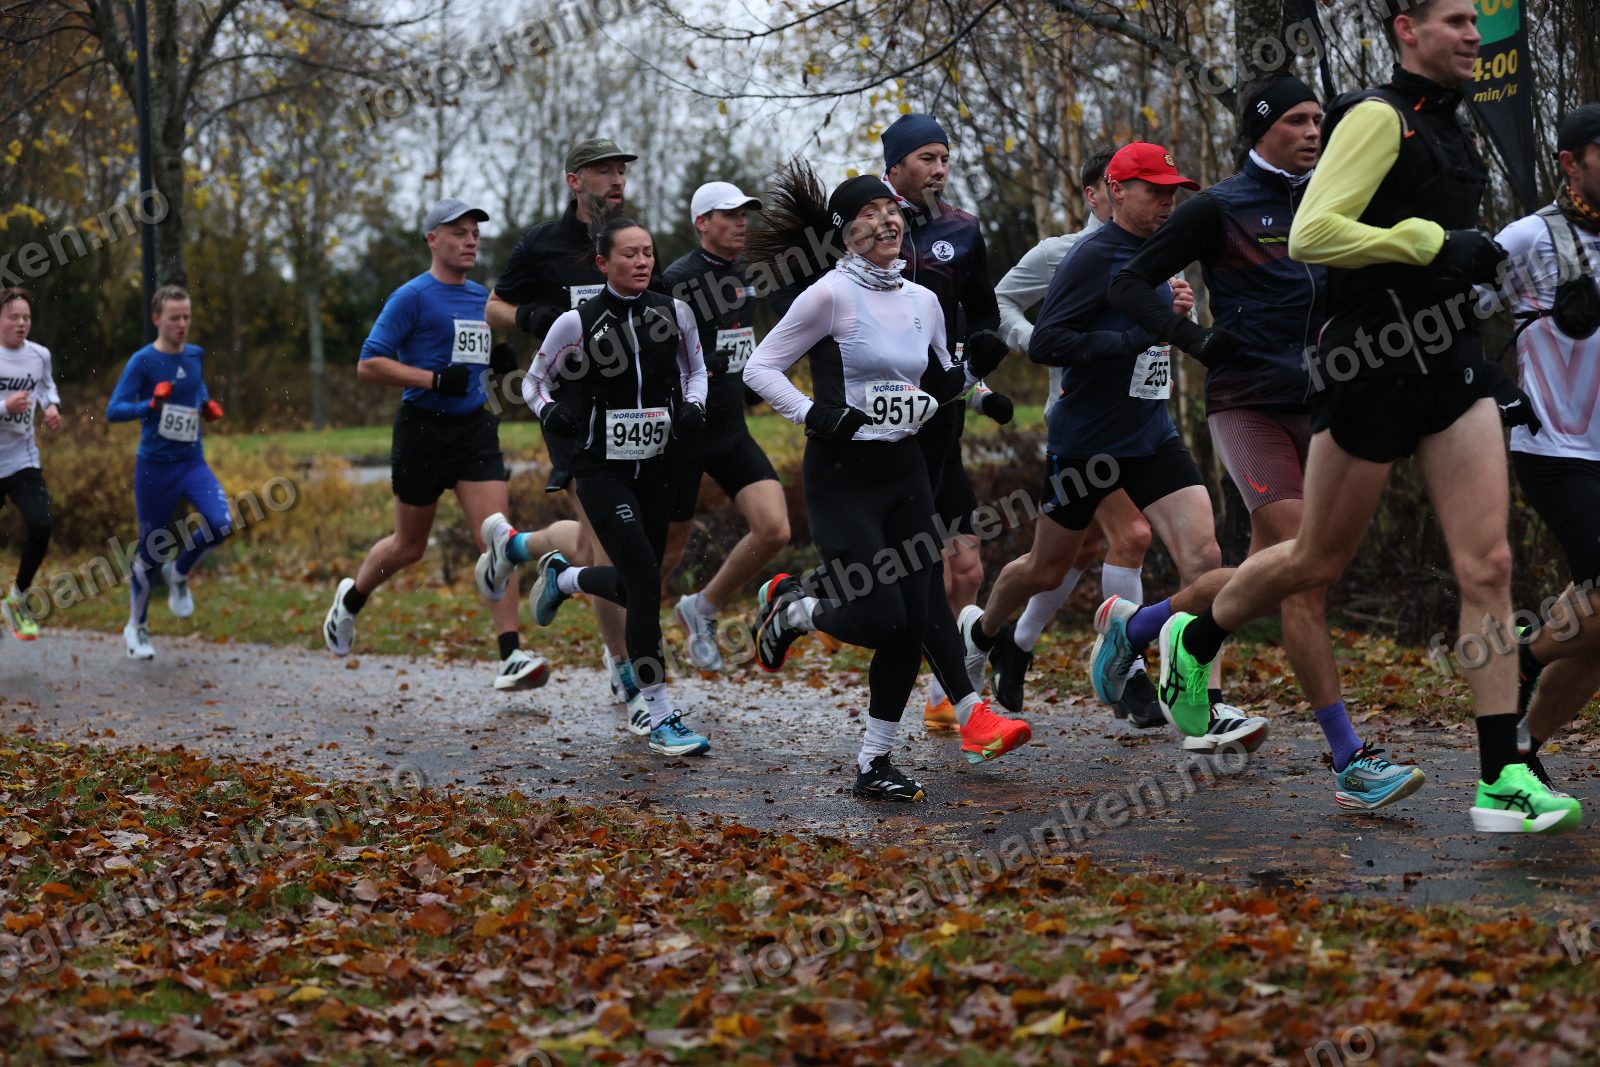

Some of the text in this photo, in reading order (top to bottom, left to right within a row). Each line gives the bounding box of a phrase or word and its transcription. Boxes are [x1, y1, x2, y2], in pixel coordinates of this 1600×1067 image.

[1472, 49, 1518, 82] 4:00
[458, 331, 489, 354] 9513
[1144, 361, 1168, 387] 255
[612, 410, 665, 420] NORGESTESTEN
[873, 395, 931, 426] 9517
[613, 421, 665, 447] 9495
